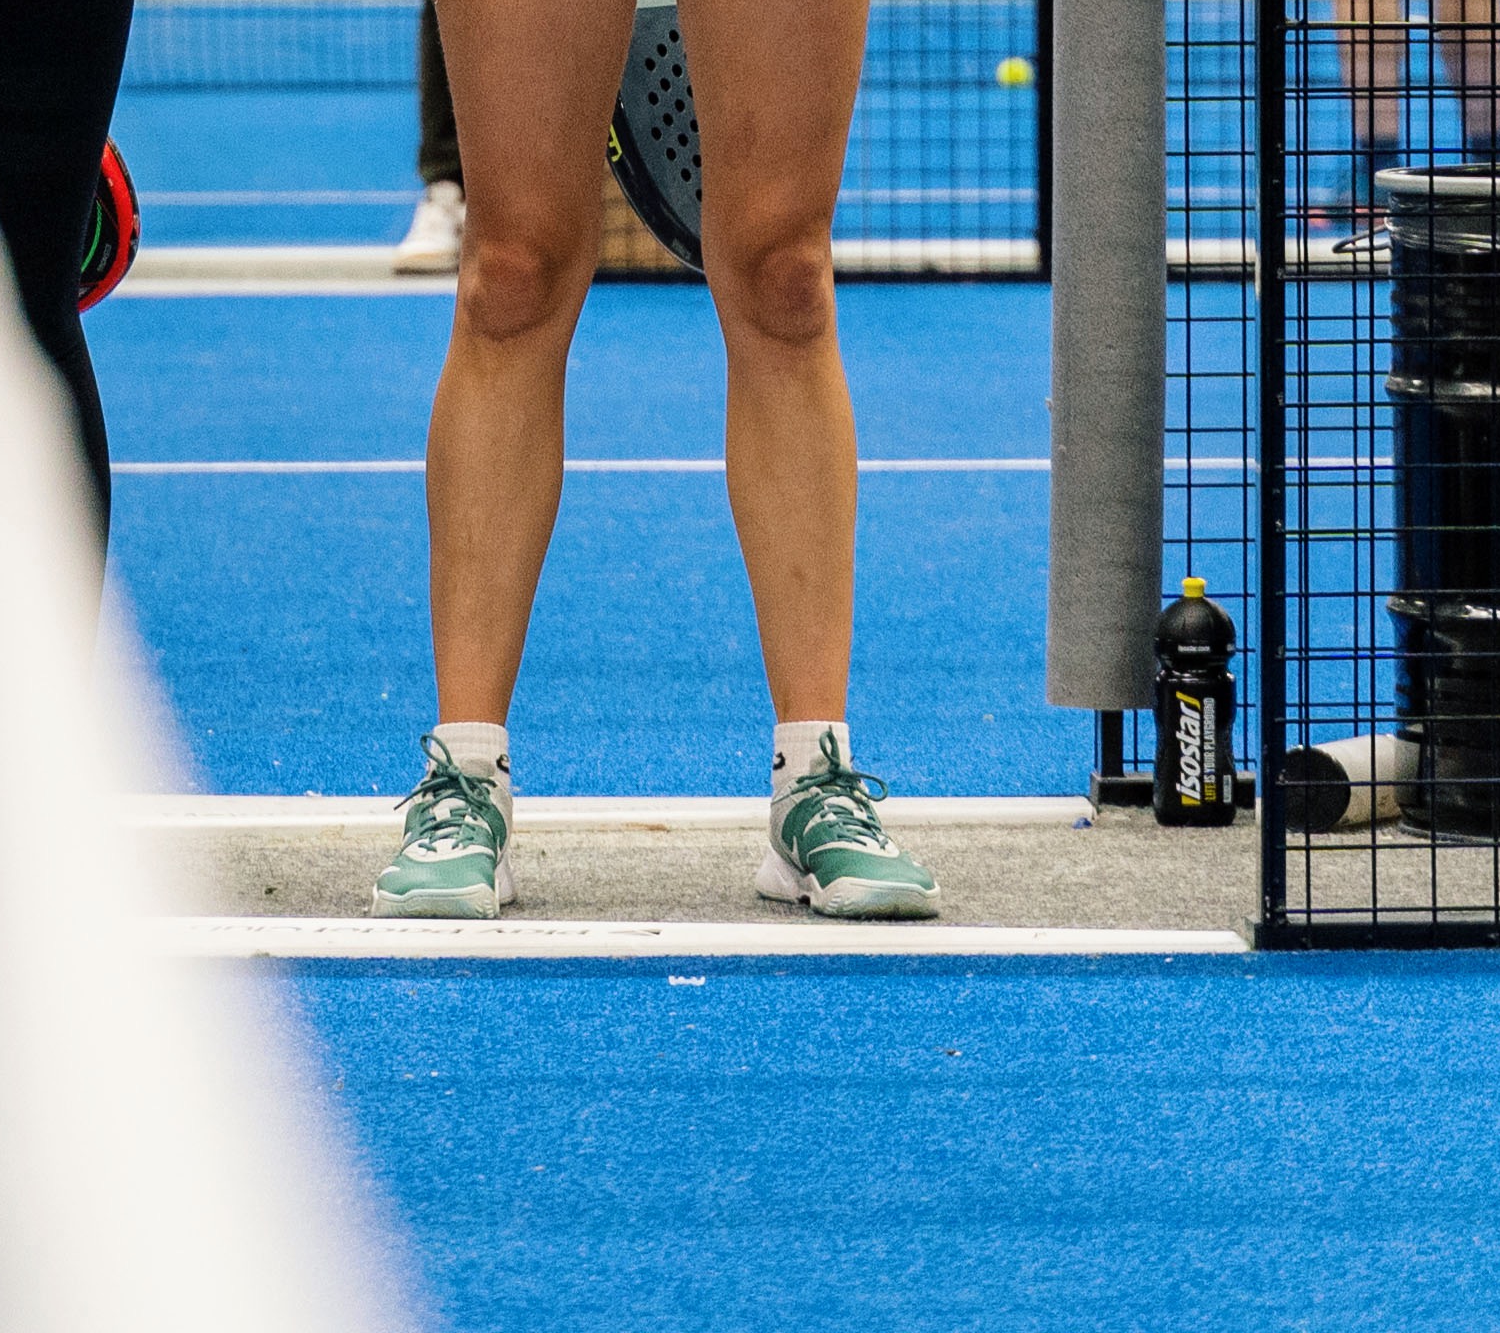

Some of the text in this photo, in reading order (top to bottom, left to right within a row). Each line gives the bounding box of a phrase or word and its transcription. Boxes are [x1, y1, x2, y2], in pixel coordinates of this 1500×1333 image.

[1202, 696, 1216, 750] PLAYGROUND
[1175, 700, 1201, 801] isostar
[1203, 751, 1216, 772] YOUR
[1203, 773, 1216, 782] IS
